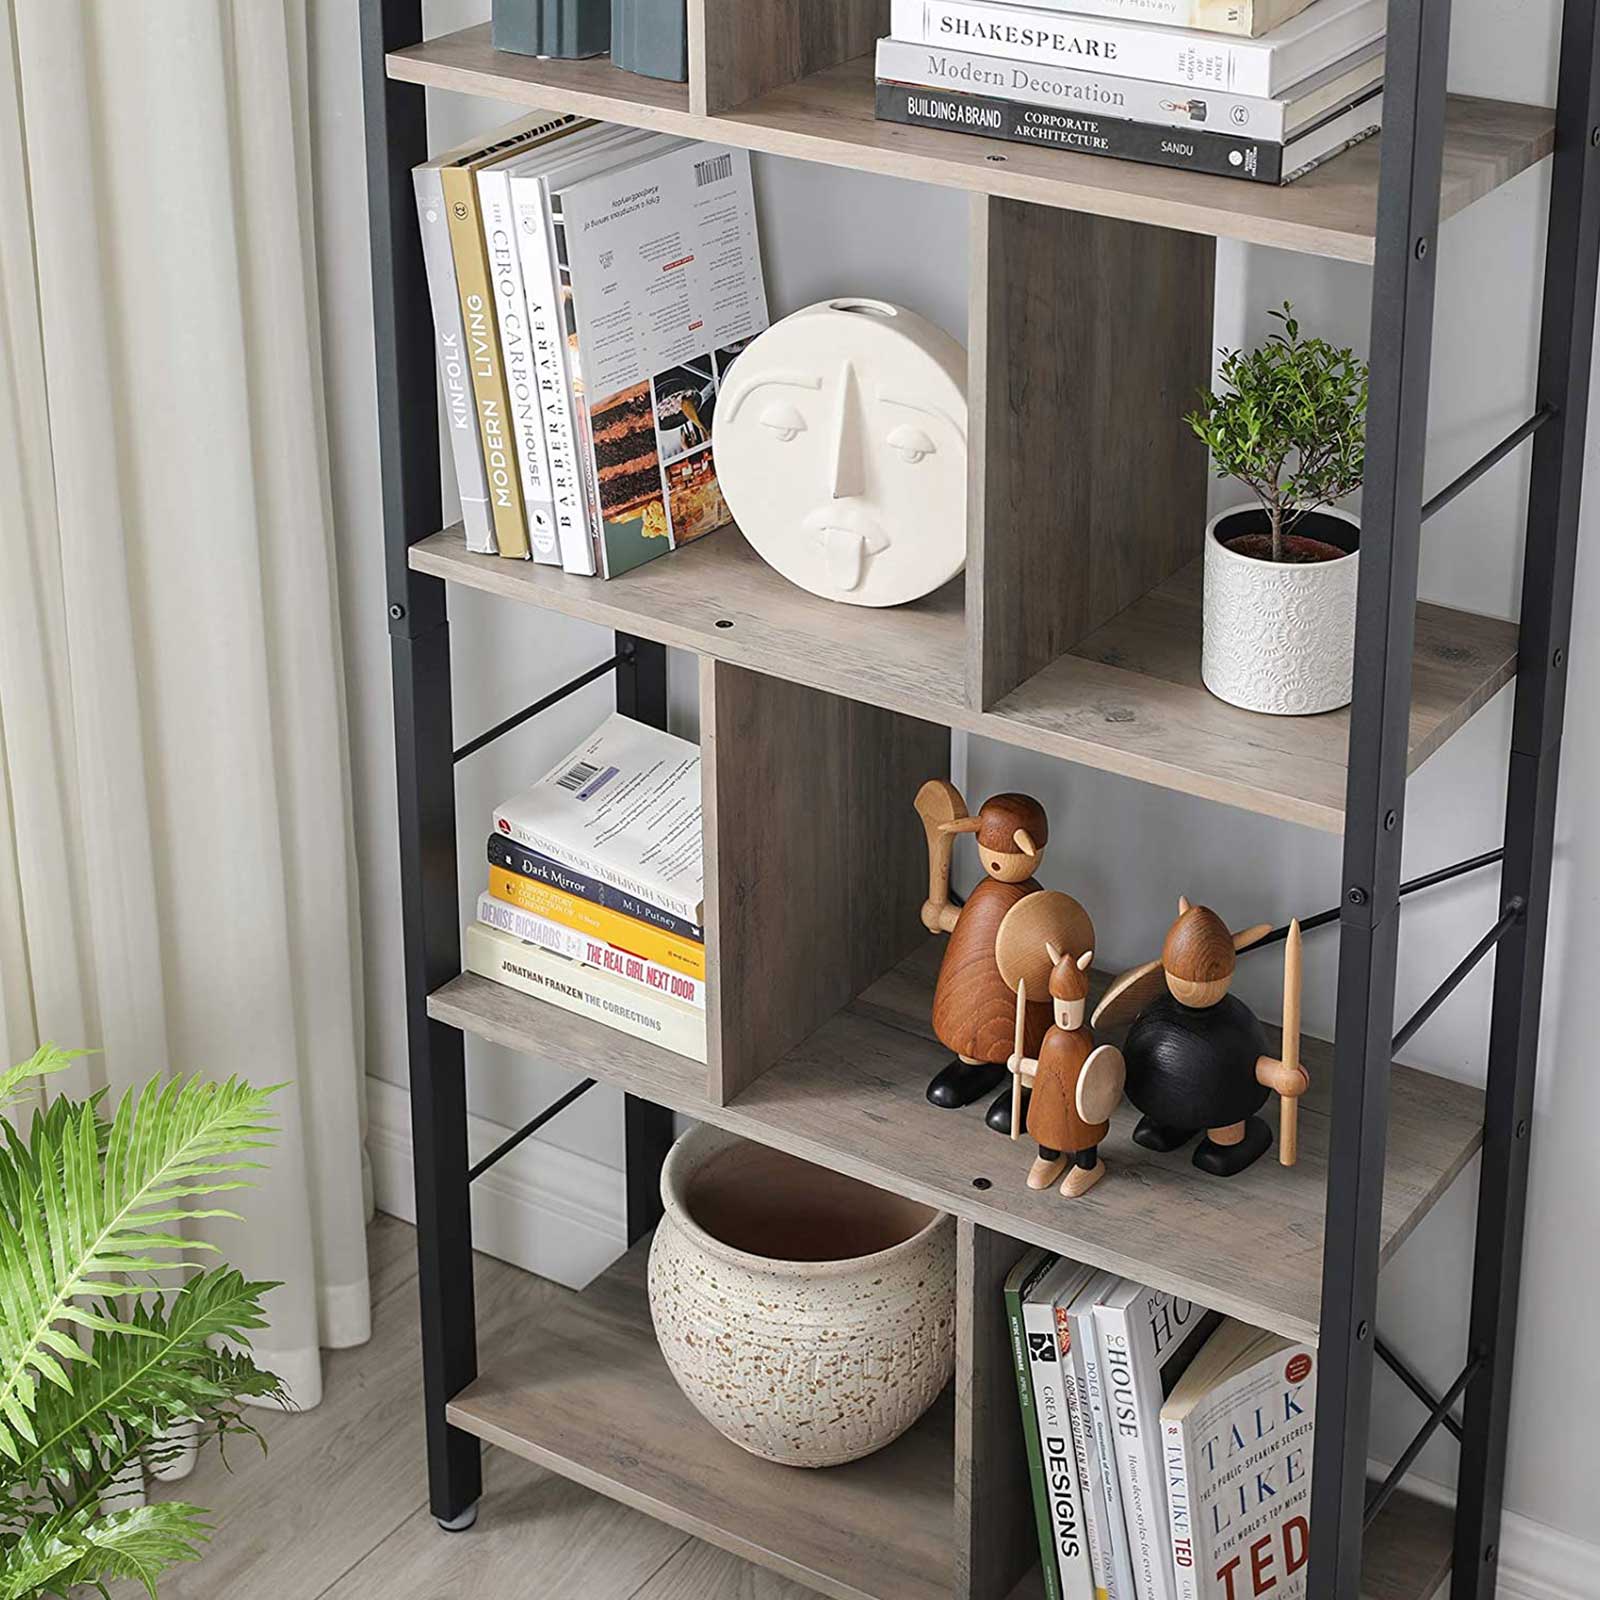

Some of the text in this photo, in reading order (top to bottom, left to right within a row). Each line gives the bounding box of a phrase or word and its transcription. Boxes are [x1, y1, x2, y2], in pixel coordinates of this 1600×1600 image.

[939, 15, 1119, 60] SHAKESPEARE
[927, 55, 1125, 106] Modern Decoration
[1178, 53, 1186, 72] THE
[1187, 48, 1196, 81] GRAVE
[1196, 59, 1204, 73] OF
[1205, 57, 1214, 76] THE
[1214, 55, 1223, 81] POET
[1014, 125, 1110, 150] ARCHITECTURE
[1024, 110, 1099, 133] CORPORATE
[1160, 140, 1195, 157] SANDU
[441, 332, 469, 431] KINFOLK
[466, 294, 514, 508] MODERN LIVING
[522, 424, 542, 487] HOUSE
[521, 858, 586, 894] Dark Mirror
[594, 866, 655, 900] HUMPHRYS
[622, 899, 677, 930] M. J. Putney
[657, 894, 689, 916] JOHN
[480, 902, 513, 932] DENISE
[514, 914, 562, 949] RICHARDS
[586, 942, 603, 966] THE
[602, 951, 625, 975] REAL
[625, 958, 646, 982] GIRL
[646, 967, 671, 991] NEXT
[671, 976, 695, 1002] DOOR
[501, 960, 662, 1032] JONATHAN FRANZEN THE CORRECTIONS
[1105, 1334, 1127, 1348] PC
[1086, 1361, 1100, 1398] DOLCI
[1107, 1348, 1139, 1439] HOUSE
[1042, 1385, 1058, 1427] GREAT
[1064, 1373, 1091, 1494] COOKING SOUTHERN HOME
[1200, 1385, 1306, 1474] TALK
[1280, 1421, 1314, 1448] SECRETS
[1127, 1453, 1139, 1484] Home
[1167, 1446, 1185, 1488] TALK
[1046, 1436, 1081, 1558] DESIGNS
[1131, 1483, 1143, 1513] decor
[1211, 1448, 1306, 1538] LIKE
[1135, 1512, 1148, 1541] styles
[1171, 1493, 1190, 1535] LIKE
[1222, 1536, 1236, 1555] THE
[1237, 1513, 1269, 1543] WORLD'S
[1269, 1503, 1283, 1521] TOP
[1284, 1488, 1308, 1512] MINDS
[1174, 1537, 1193, 1569] TED
[1216, 1515, 1310, 1600] TED
